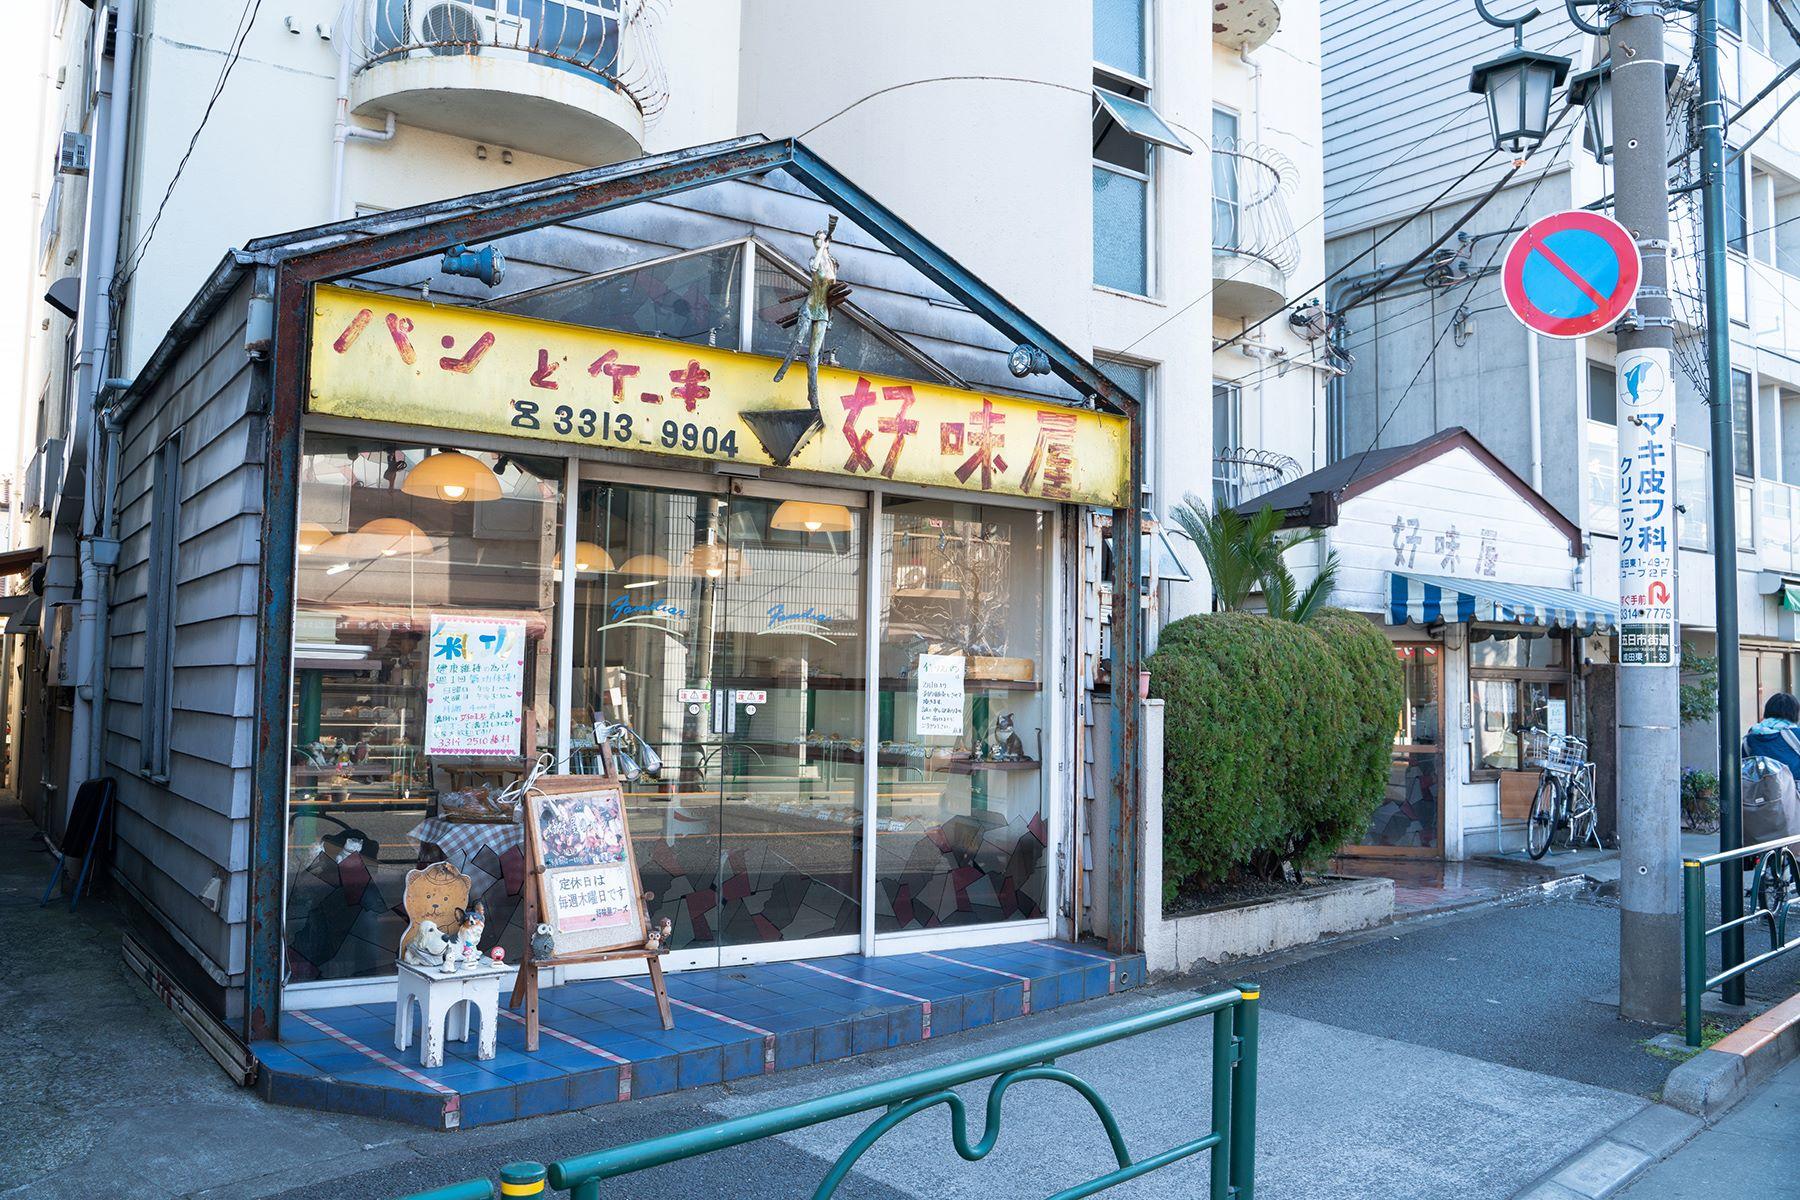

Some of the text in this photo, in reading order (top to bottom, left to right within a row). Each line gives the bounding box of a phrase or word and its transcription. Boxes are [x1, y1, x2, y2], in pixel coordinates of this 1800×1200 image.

[840, 376, 1078, 499] 好味屋
[1620, 457, 1635, 554] クリニック
[1637, 413, 1667, 553] マキ皮フ科
[1391, 515, 1500, 577] 好味屋
[558, 874, 606, 891] 定休日は
[558, 885, 627, 910] 毎週木曜日です
